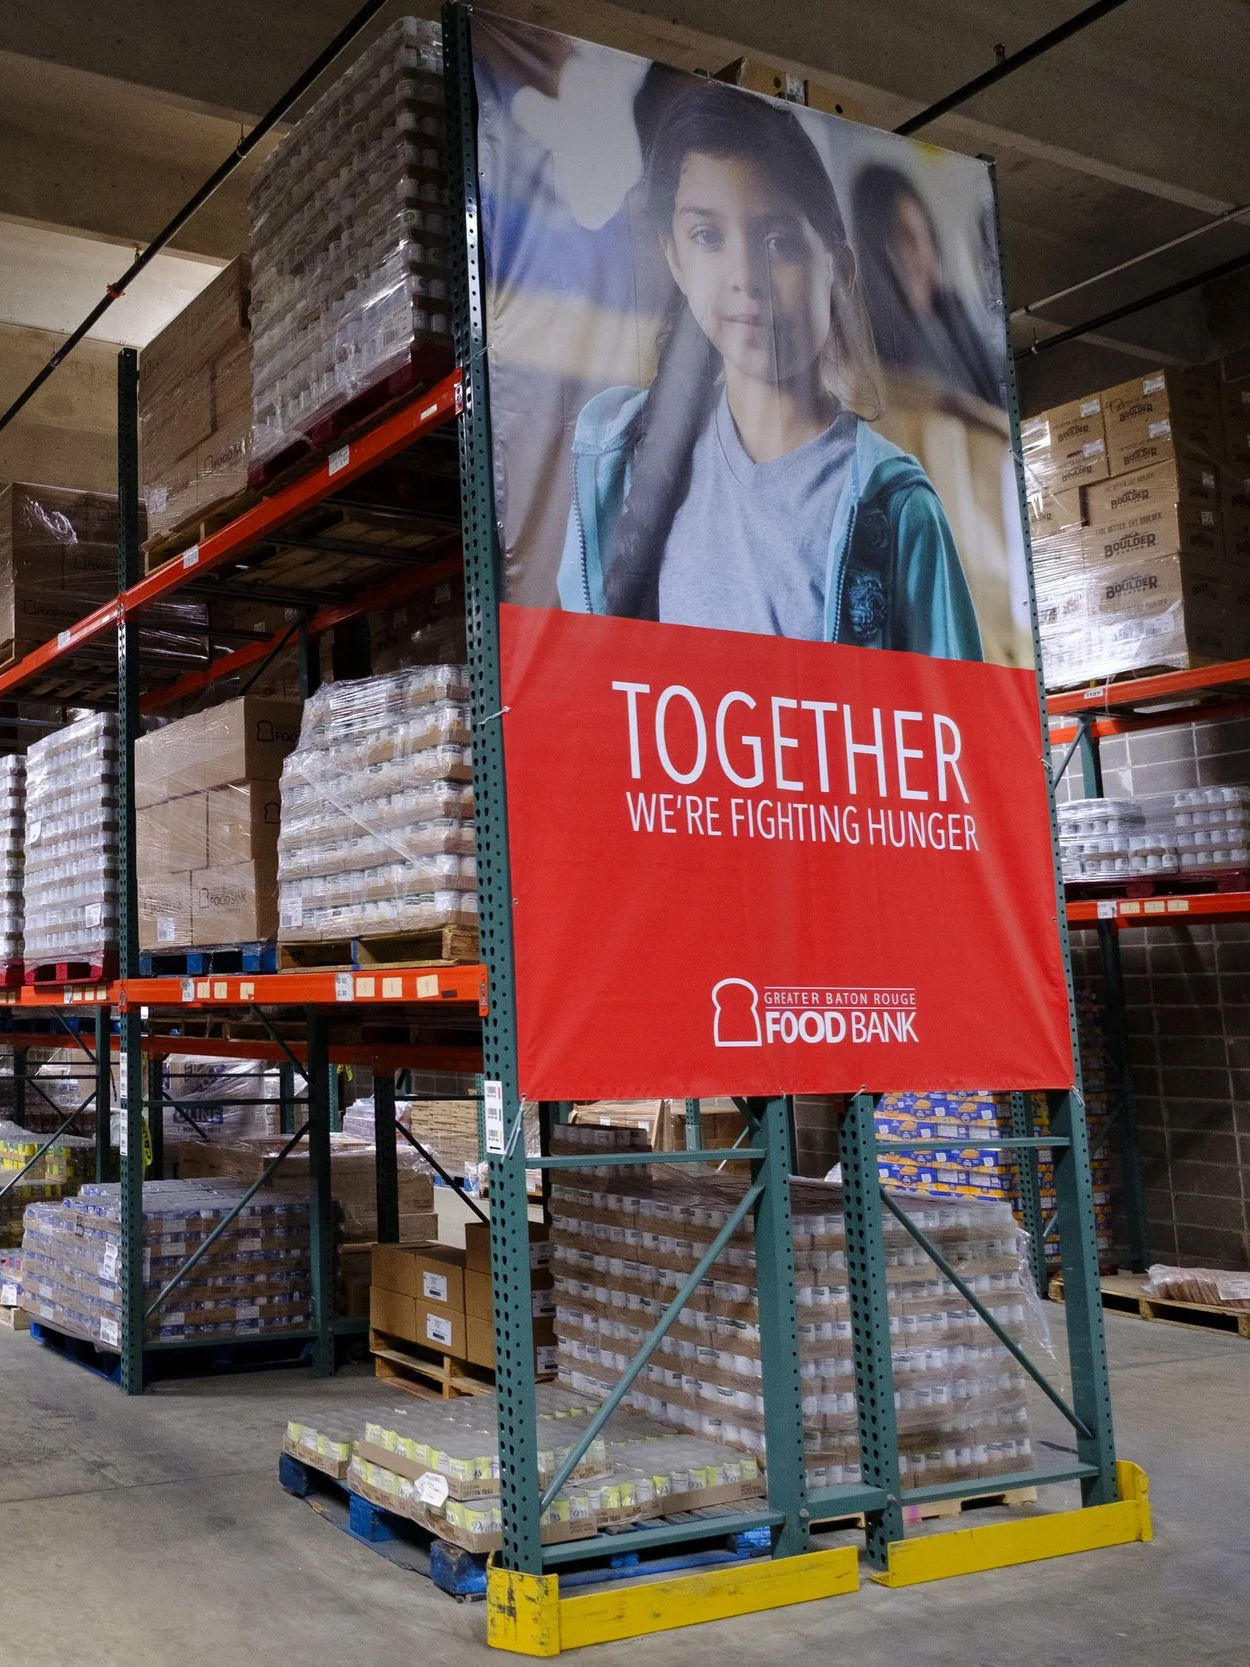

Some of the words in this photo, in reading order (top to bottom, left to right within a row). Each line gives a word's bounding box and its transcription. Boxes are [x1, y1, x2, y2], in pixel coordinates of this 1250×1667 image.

[1111, 490, 1150, 509] BOULDER
[1104, 533, 1157, 558] BOULDER
[1105, 575, 1159, 599] BOULDER
[276, 732, 298, 743] FOO
[611, 681, 970, 804] TOGETHER
[626, 791, 723, 837] WE'RE
[731, 798, 860, 845] FIGHTING
[868, 809, 980, 852] HUNGER
[764, 991, 820, 1005] GREATER
[826, 992, 868, 1006] BATON
[874, 993, 917, 1006] ROUGE
[766, 1011, 847, 1044] FOOD
[851, 1012, 919, 1043] BANK
